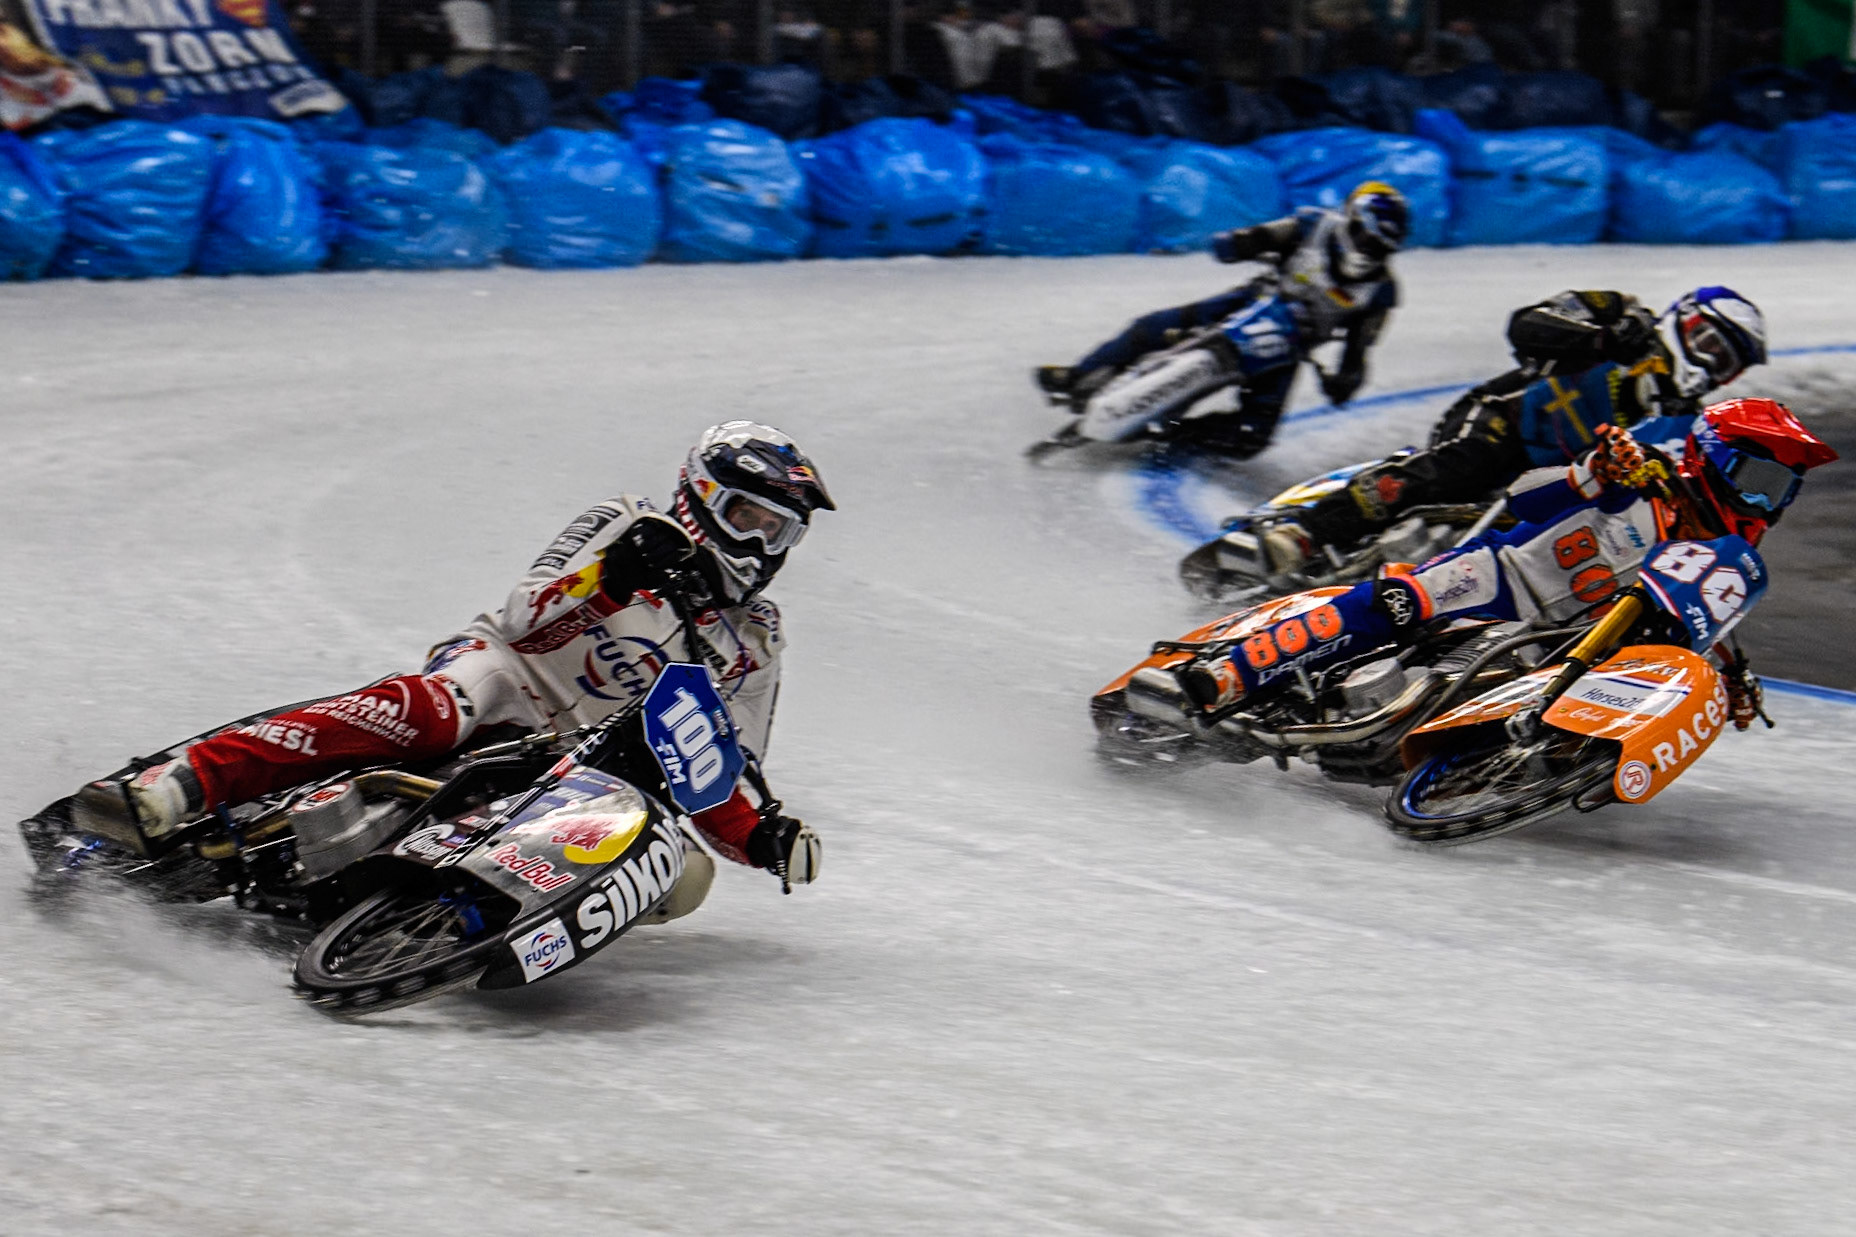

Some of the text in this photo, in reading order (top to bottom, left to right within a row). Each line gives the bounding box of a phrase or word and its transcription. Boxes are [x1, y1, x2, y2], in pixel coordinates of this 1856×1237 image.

[137, 30, 297, 75] ZORN
[1685, 602, 1709, 640] FIM
[583, 625, 648, 697] FUCH
[656, 738, 687, 785] FIM
[658, 687, 724, 793] 100
[525, 936, 567, 966] FUCHS
